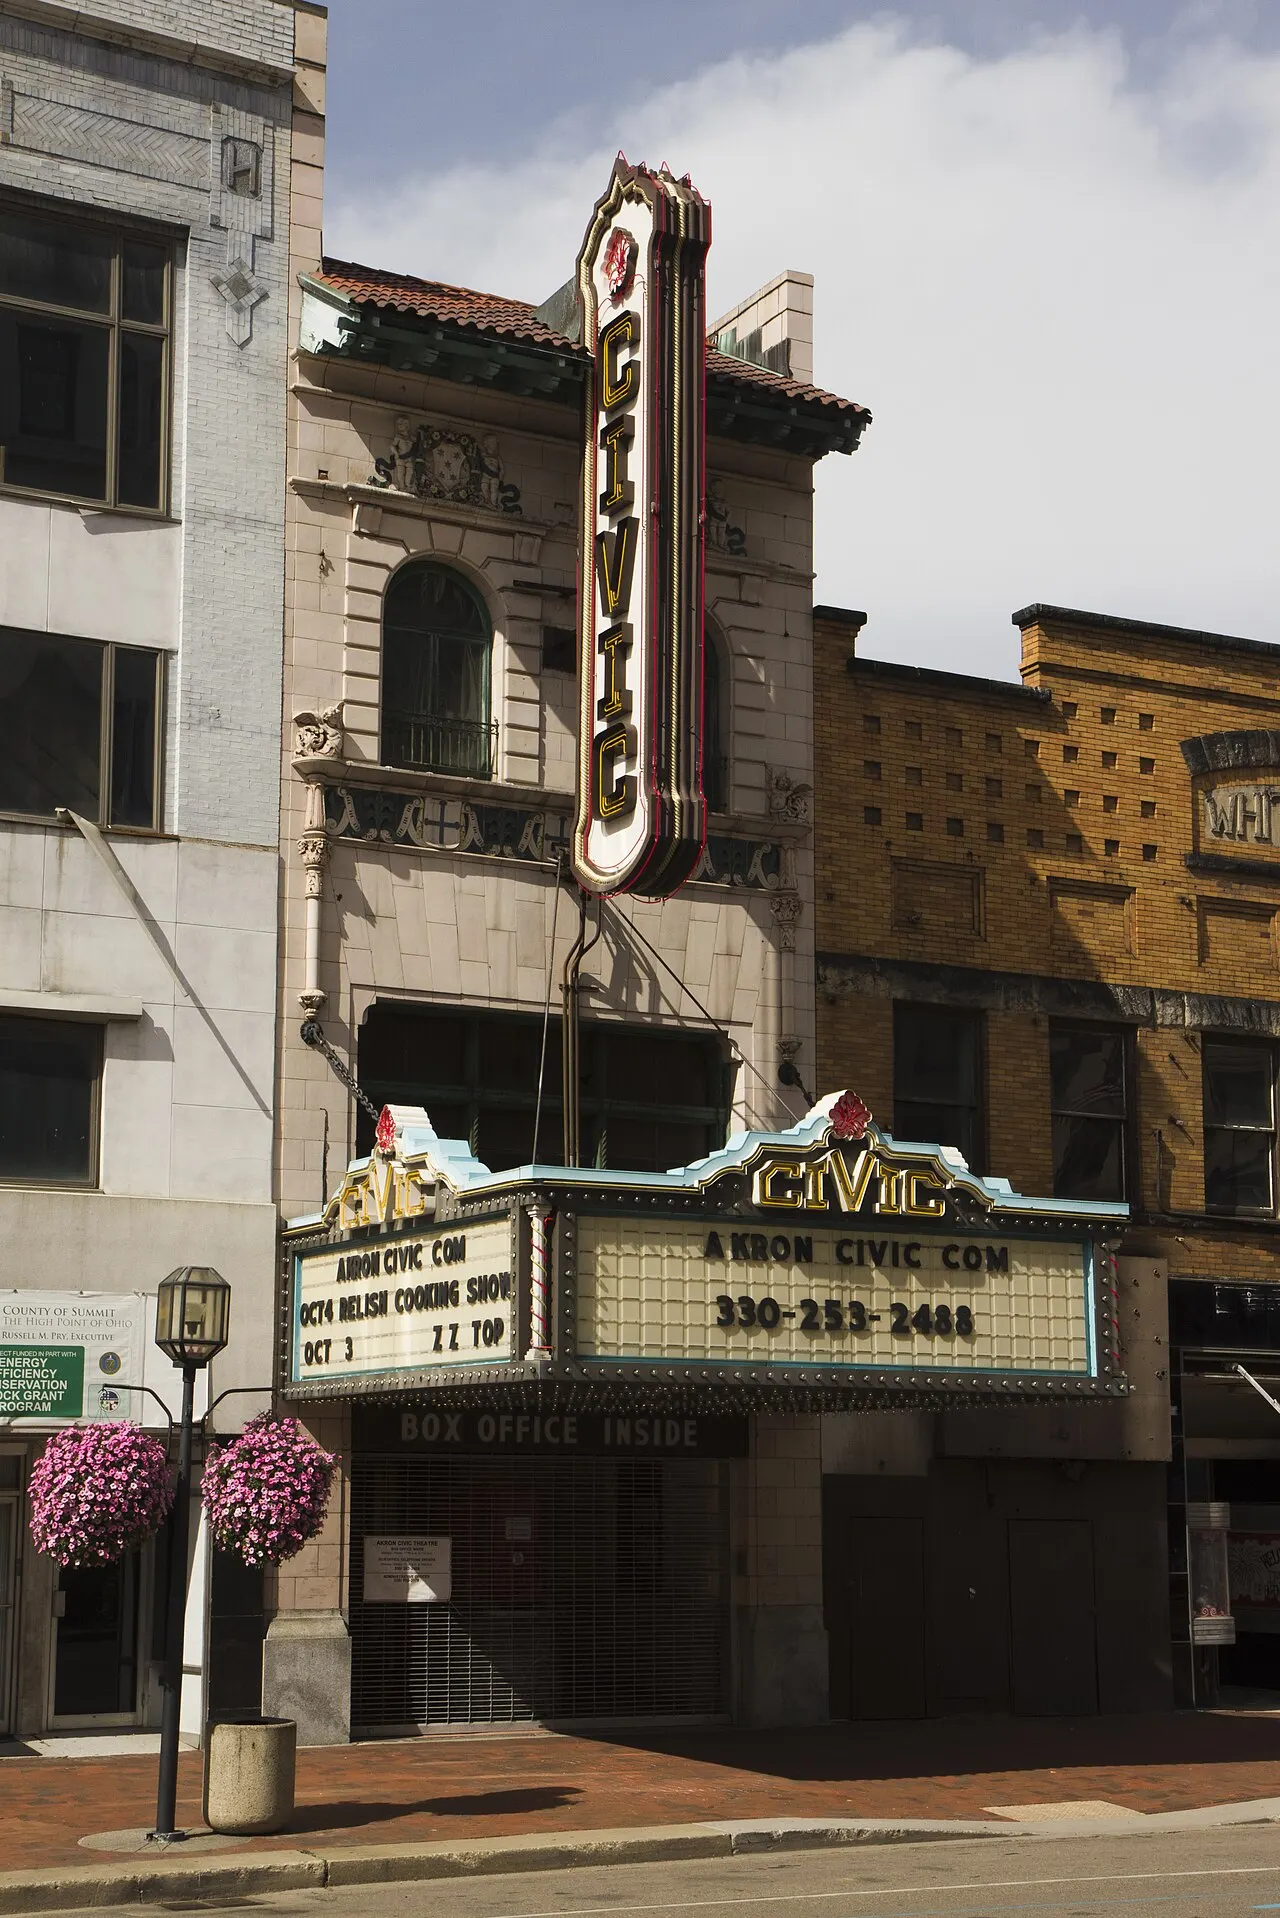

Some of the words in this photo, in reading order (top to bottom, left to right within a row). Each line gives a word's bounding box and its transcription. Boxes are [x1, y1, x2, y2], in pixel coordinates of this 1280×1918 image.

[593, 310, 640, 822] CIVIC
[340, 1161, 430, 1230] CIVIC
[752, 1149, 946, 1217] CIVIC
[336, 1251, 380, 1282] AKRON
[383, 1243, 423, 1274] CIVIC
[431, 1235, 466, 1266] COM
[704, 1231, 813, 1263] AKRON
[836, 1238, 921, 1268] CIVIC
[942, 1243, 1009, 1273] COM
[2, 1305, 51, 1316] COUNTY
[54, 1307, 68, 1316] OF
[71, 1307, 116, 1317] SUMMIT
[339, 1290, 388, 1321] RELISH
[395, 1279, 460, 1313] COOKING
[466, 1271, 511, 1304] SHOW
[2, 1331, 36, 1340] RUSSELL
[71, 1332, 115, 1341] EXECUTIVE
[4, 1317, 22, 1326] THE
[25, 1317, 53, 1326] HIGH
[57, 1318, 87, 1327] POINT
[90, 1319, 103, 1328] OF
[105, 1319, 133, 1328] OHIO
[61, 1351, 77, 1359] WITH
[304, 1338, 332, 1365] OCT
[344, 1336, 353, 1361] 3
[471, 1317, 505, 1348] TOP
[0, 1358, 48, 1368] ENERGY
[0, 1380, 68, 1390] SERVATION
[23, 1391, 65, 1401] GRANT
[401, 1413, 461, 1442] BOX
[477, 1414, 578, 1444] OFFICE
[603, 1417, 698, 1447] INSIDE
